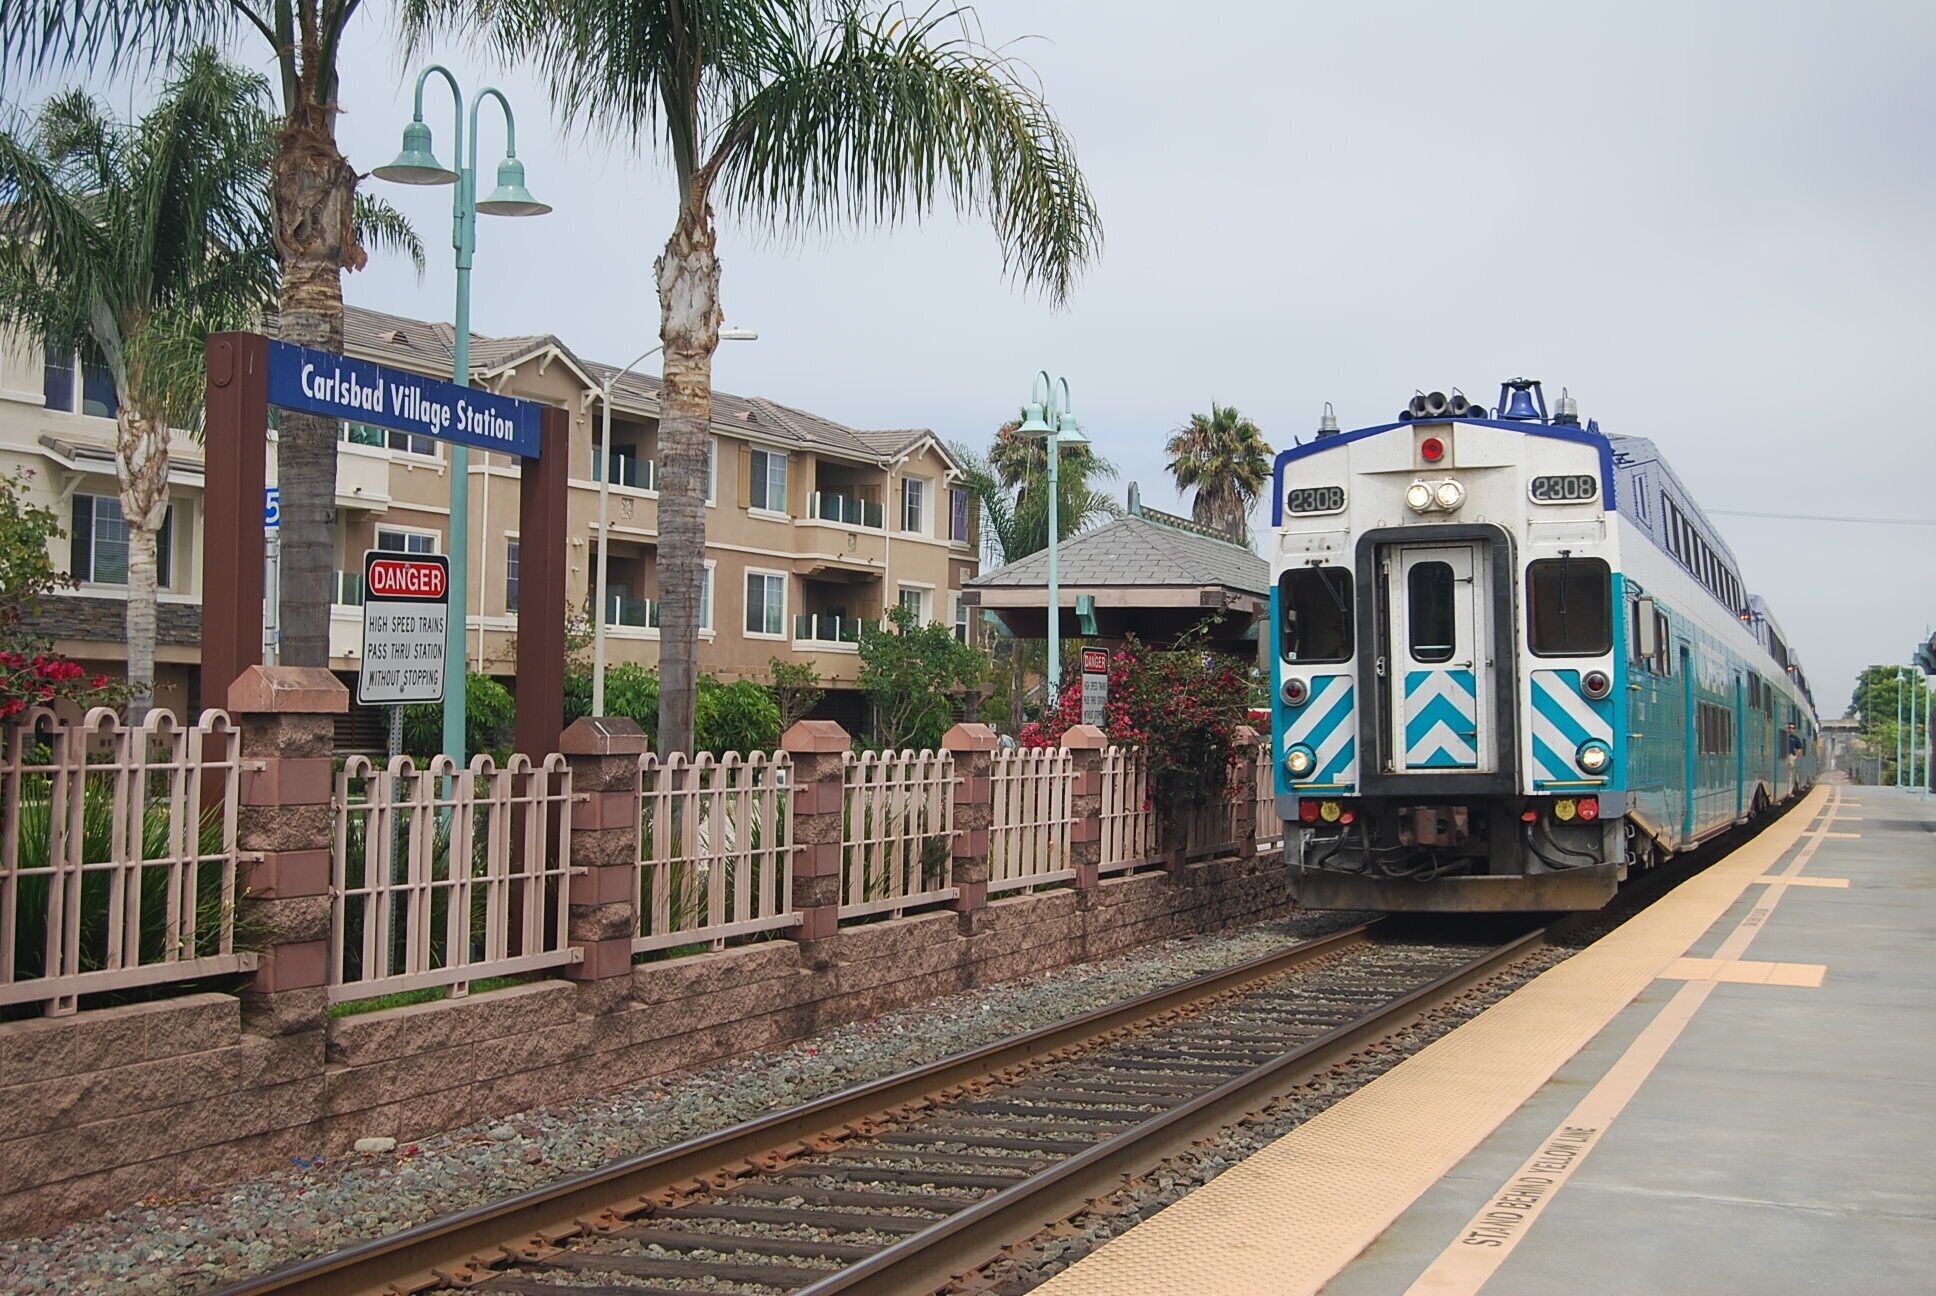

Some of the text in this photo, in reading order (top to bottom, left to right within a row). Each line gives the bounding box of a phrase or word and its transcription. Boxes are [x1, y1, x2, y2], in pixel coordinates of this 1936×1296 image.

[302, 363, 514, 441] Carlsbad Village Station
[1290, 487, 1342, 513] 2308
[1535, 476, 1592, 500] 2308
[374, 566, 442, 592] DANGER
[369, 616, 444, 634] HIGH SPEED TRAINS
[367, 643, 443, 660] PASS THRU STATION
[1084, 654, 1106, 669] DANGER
[368, 669, 439, 688] WITHOUT STOPPING
[1462, 1126, 1597, 1247] STAND BEHIND YELLOW LINE
